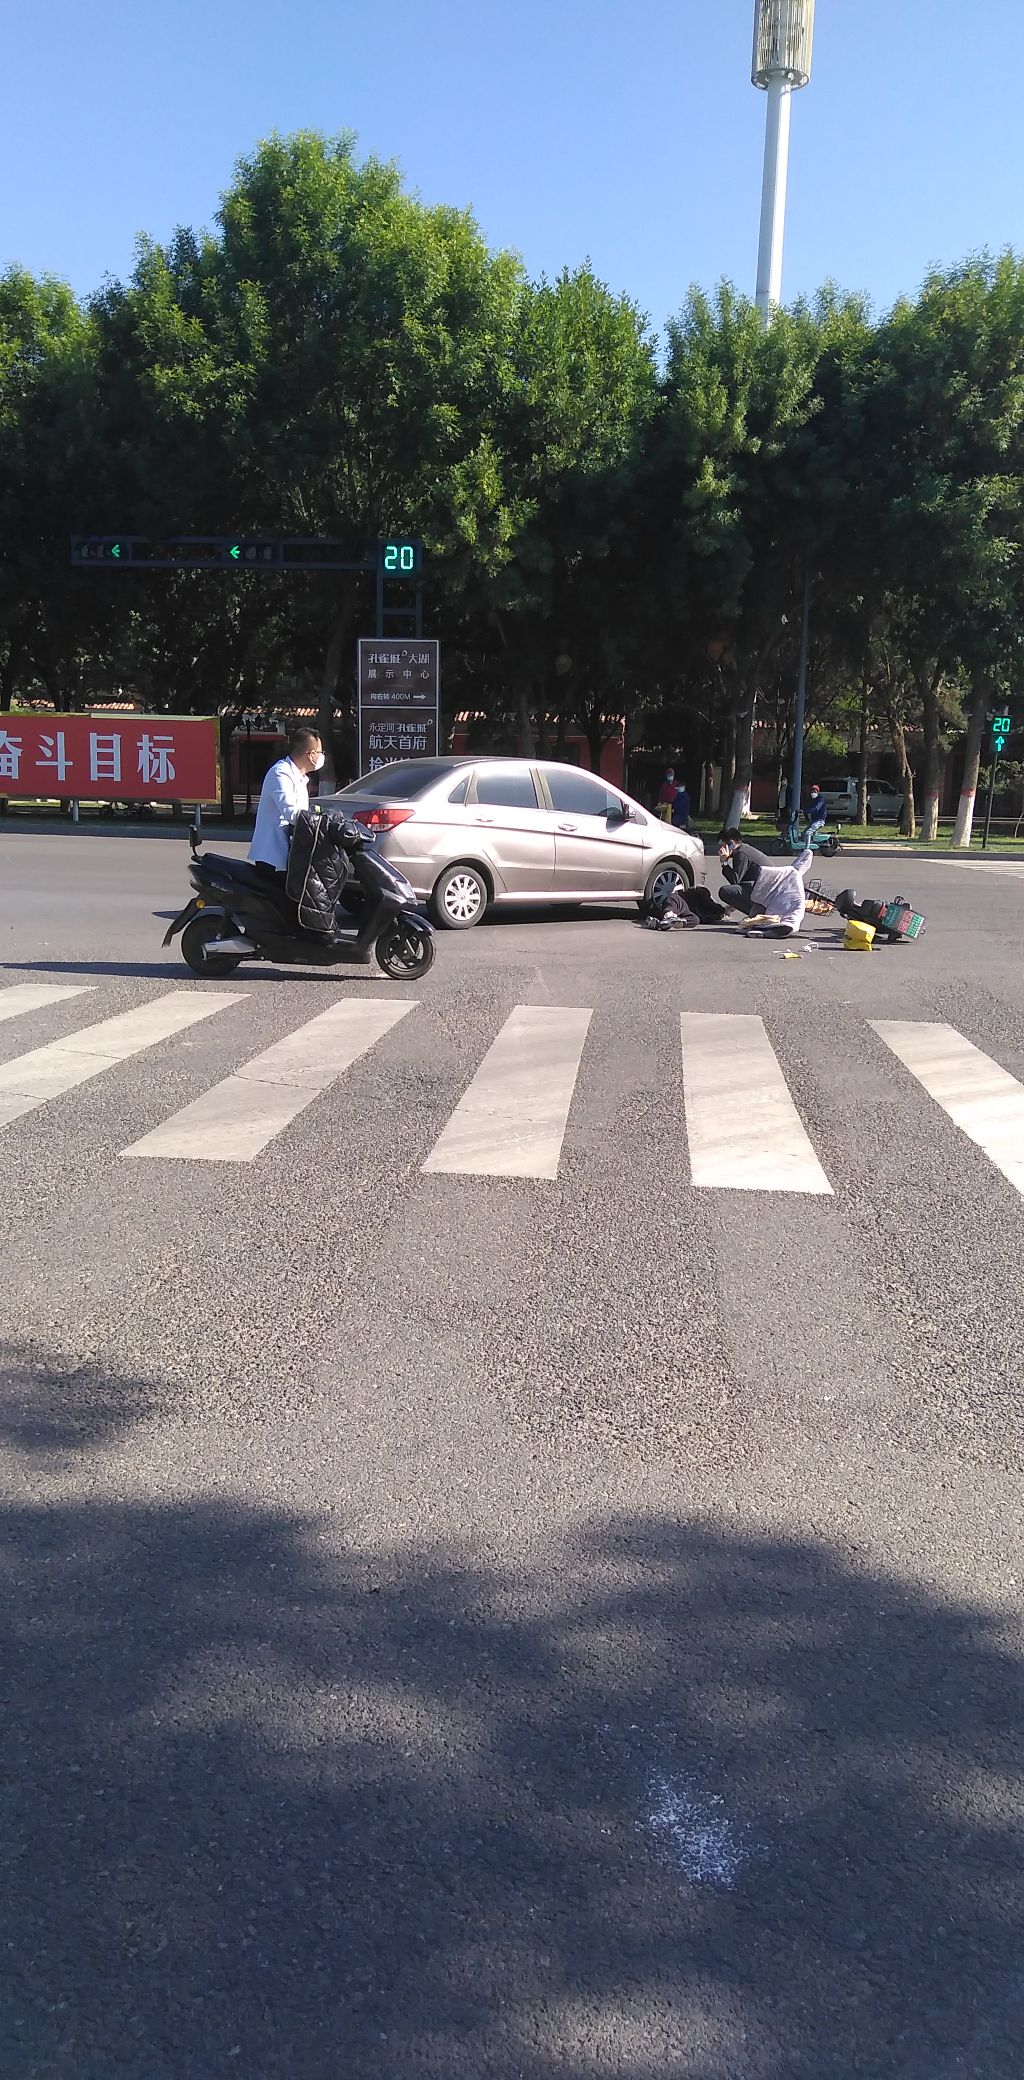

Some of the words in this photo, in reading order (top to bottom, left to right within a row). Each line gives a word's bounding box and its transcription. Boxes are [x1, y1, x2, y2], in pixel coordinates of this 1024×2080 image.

[385, 546, 413, 569] 20
[368, 654, 401, 664] 孔雀城
[408, 653, 430, 664] 大湖
[368, 669, 430, 679] 展示中心
[369, 723, 395, 732] 永定河
[397, 723, 427, 732] 孔雀城
[993, 718, 1010, 732] 20
[369, 734, 427, 750] 航天首府
